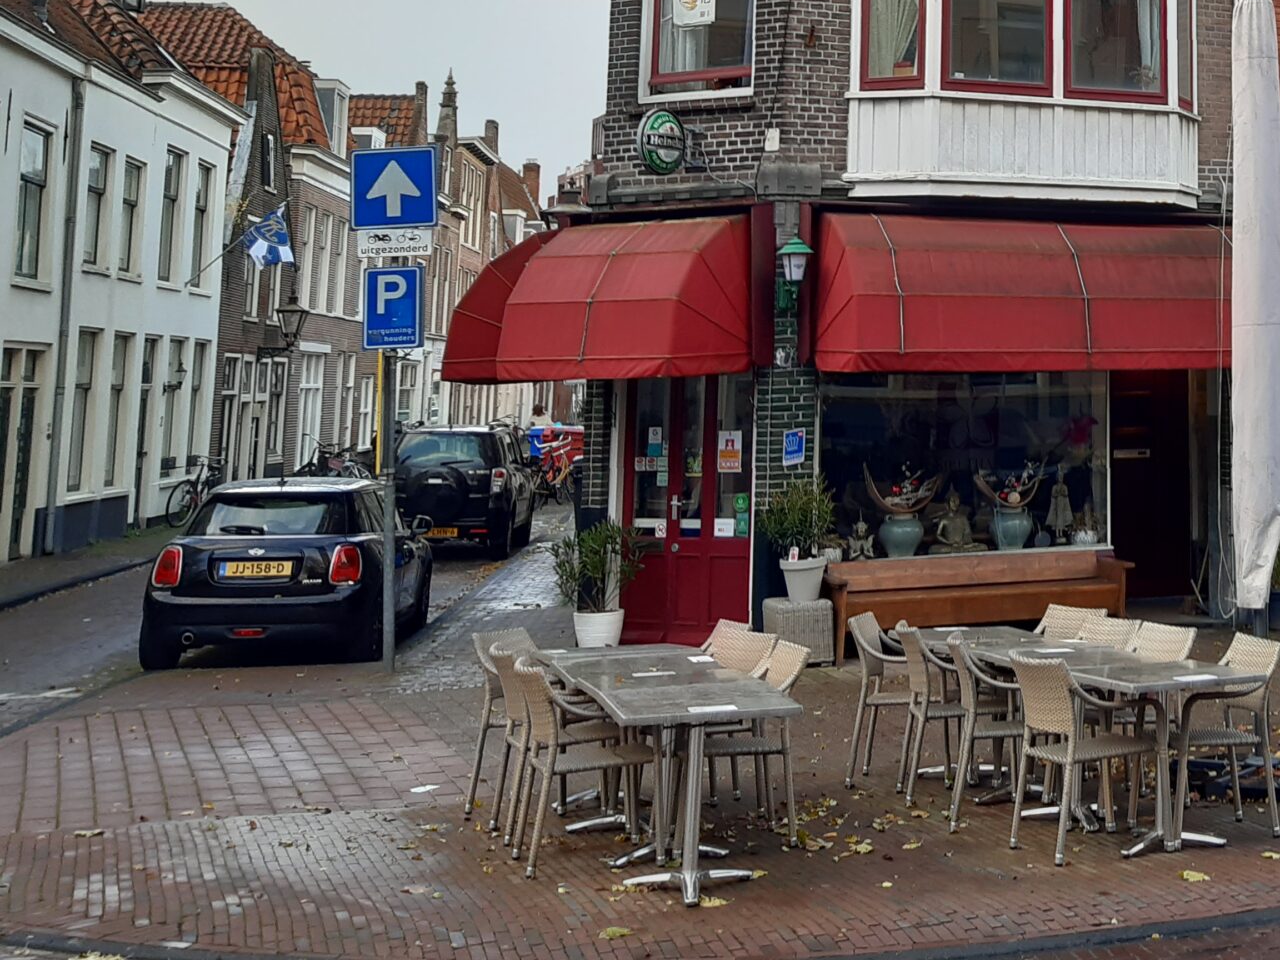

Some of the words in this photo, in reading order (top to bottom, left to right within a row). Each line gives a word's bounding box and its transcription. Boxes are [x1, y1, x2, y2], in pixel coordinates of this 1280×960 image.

[361, 244, 428, 255] uitgezonderd
[377, 274, 407, 314] P
[232, 563, 285, 575] JJ-158-D
